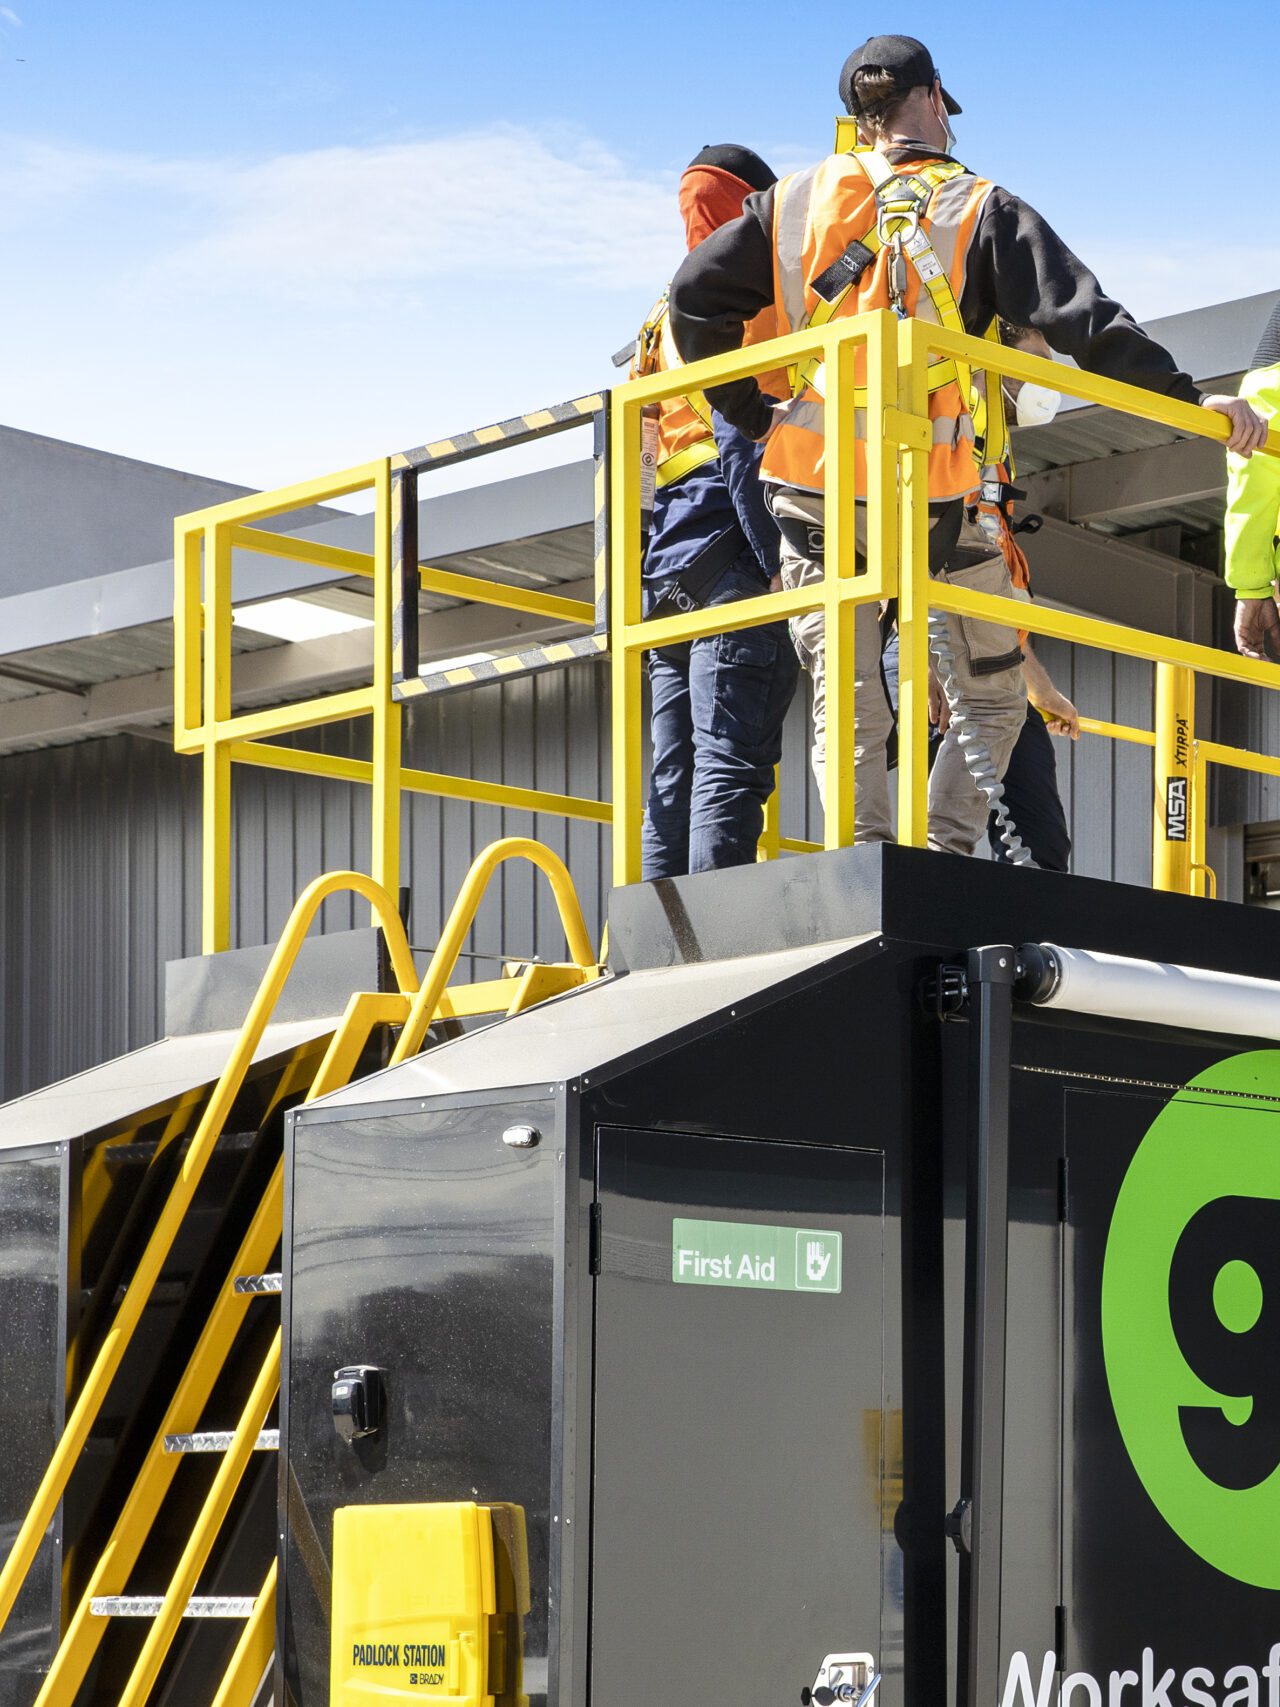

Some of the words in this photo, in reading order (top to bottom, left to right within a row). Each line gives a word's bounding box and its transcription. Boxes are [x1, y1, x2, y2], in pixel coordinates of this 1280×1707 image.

[1167, 779, 1186, 839] MSA
[678, 1249, 733, 1279] First
[736, 1254, 775, 1282] Aid
[353, 1644, 400, 1667] PADLOCK
[403, 1644, 445, 1667] STATION
[419, 1673, 444, 1685] BRADY
